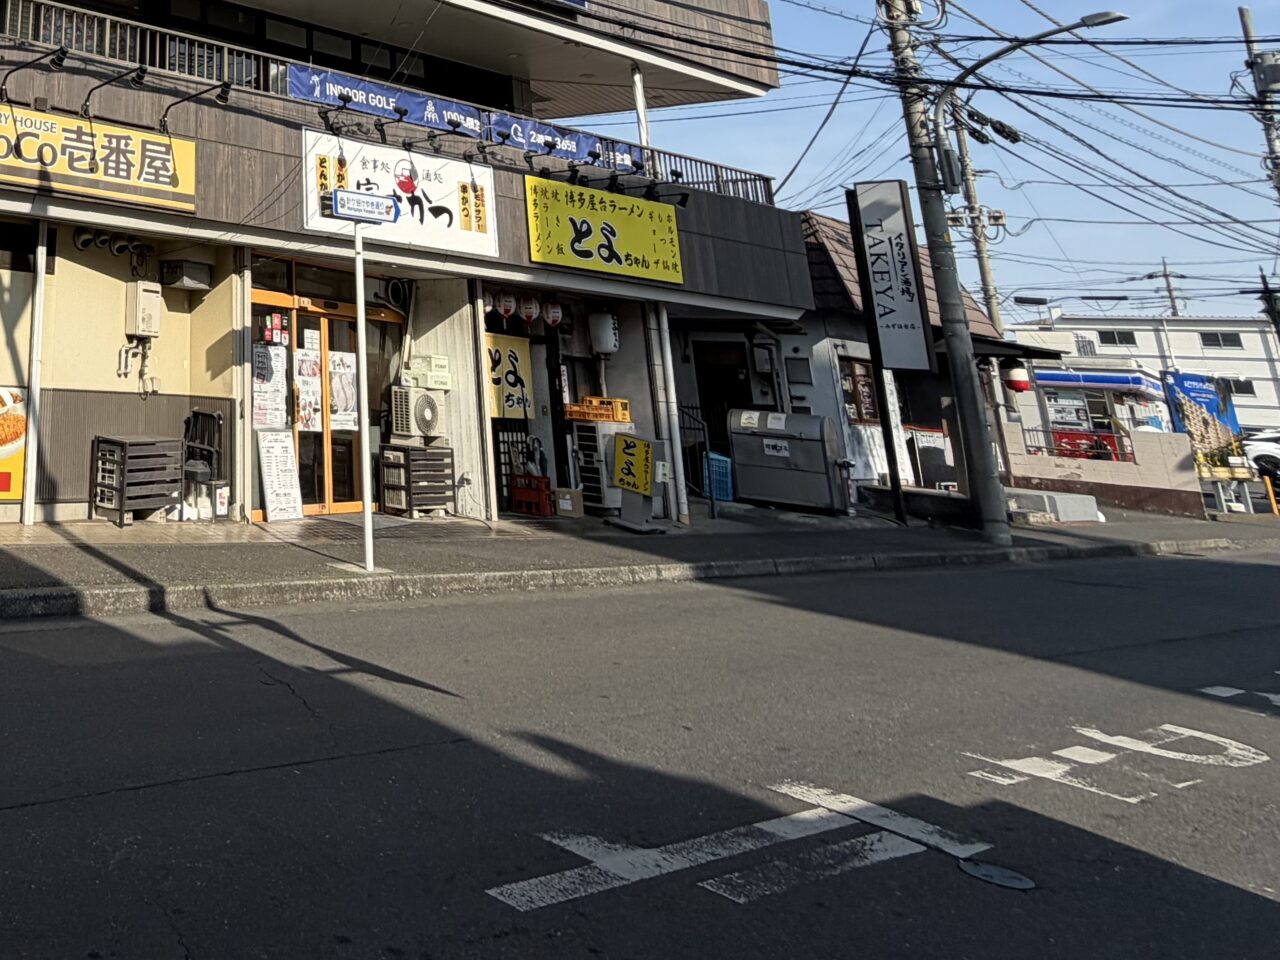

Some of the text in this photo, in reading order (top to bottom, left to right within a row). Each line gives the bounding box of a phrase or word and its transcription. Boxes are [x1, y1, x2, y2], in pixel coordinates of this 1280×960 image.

[326, 82, 397, 110] INDOOR GOLF
[14, 115, 58, 134] HOUSE
[318, 156, 332, 194] とんか
[360, 155, 391, 174] 食事処
[460, 184, 471, 219] 串かつ
[564, 190, 645, 219] 博多屋台ラーメン
[865, 218, 897, 319] TAKEYA
